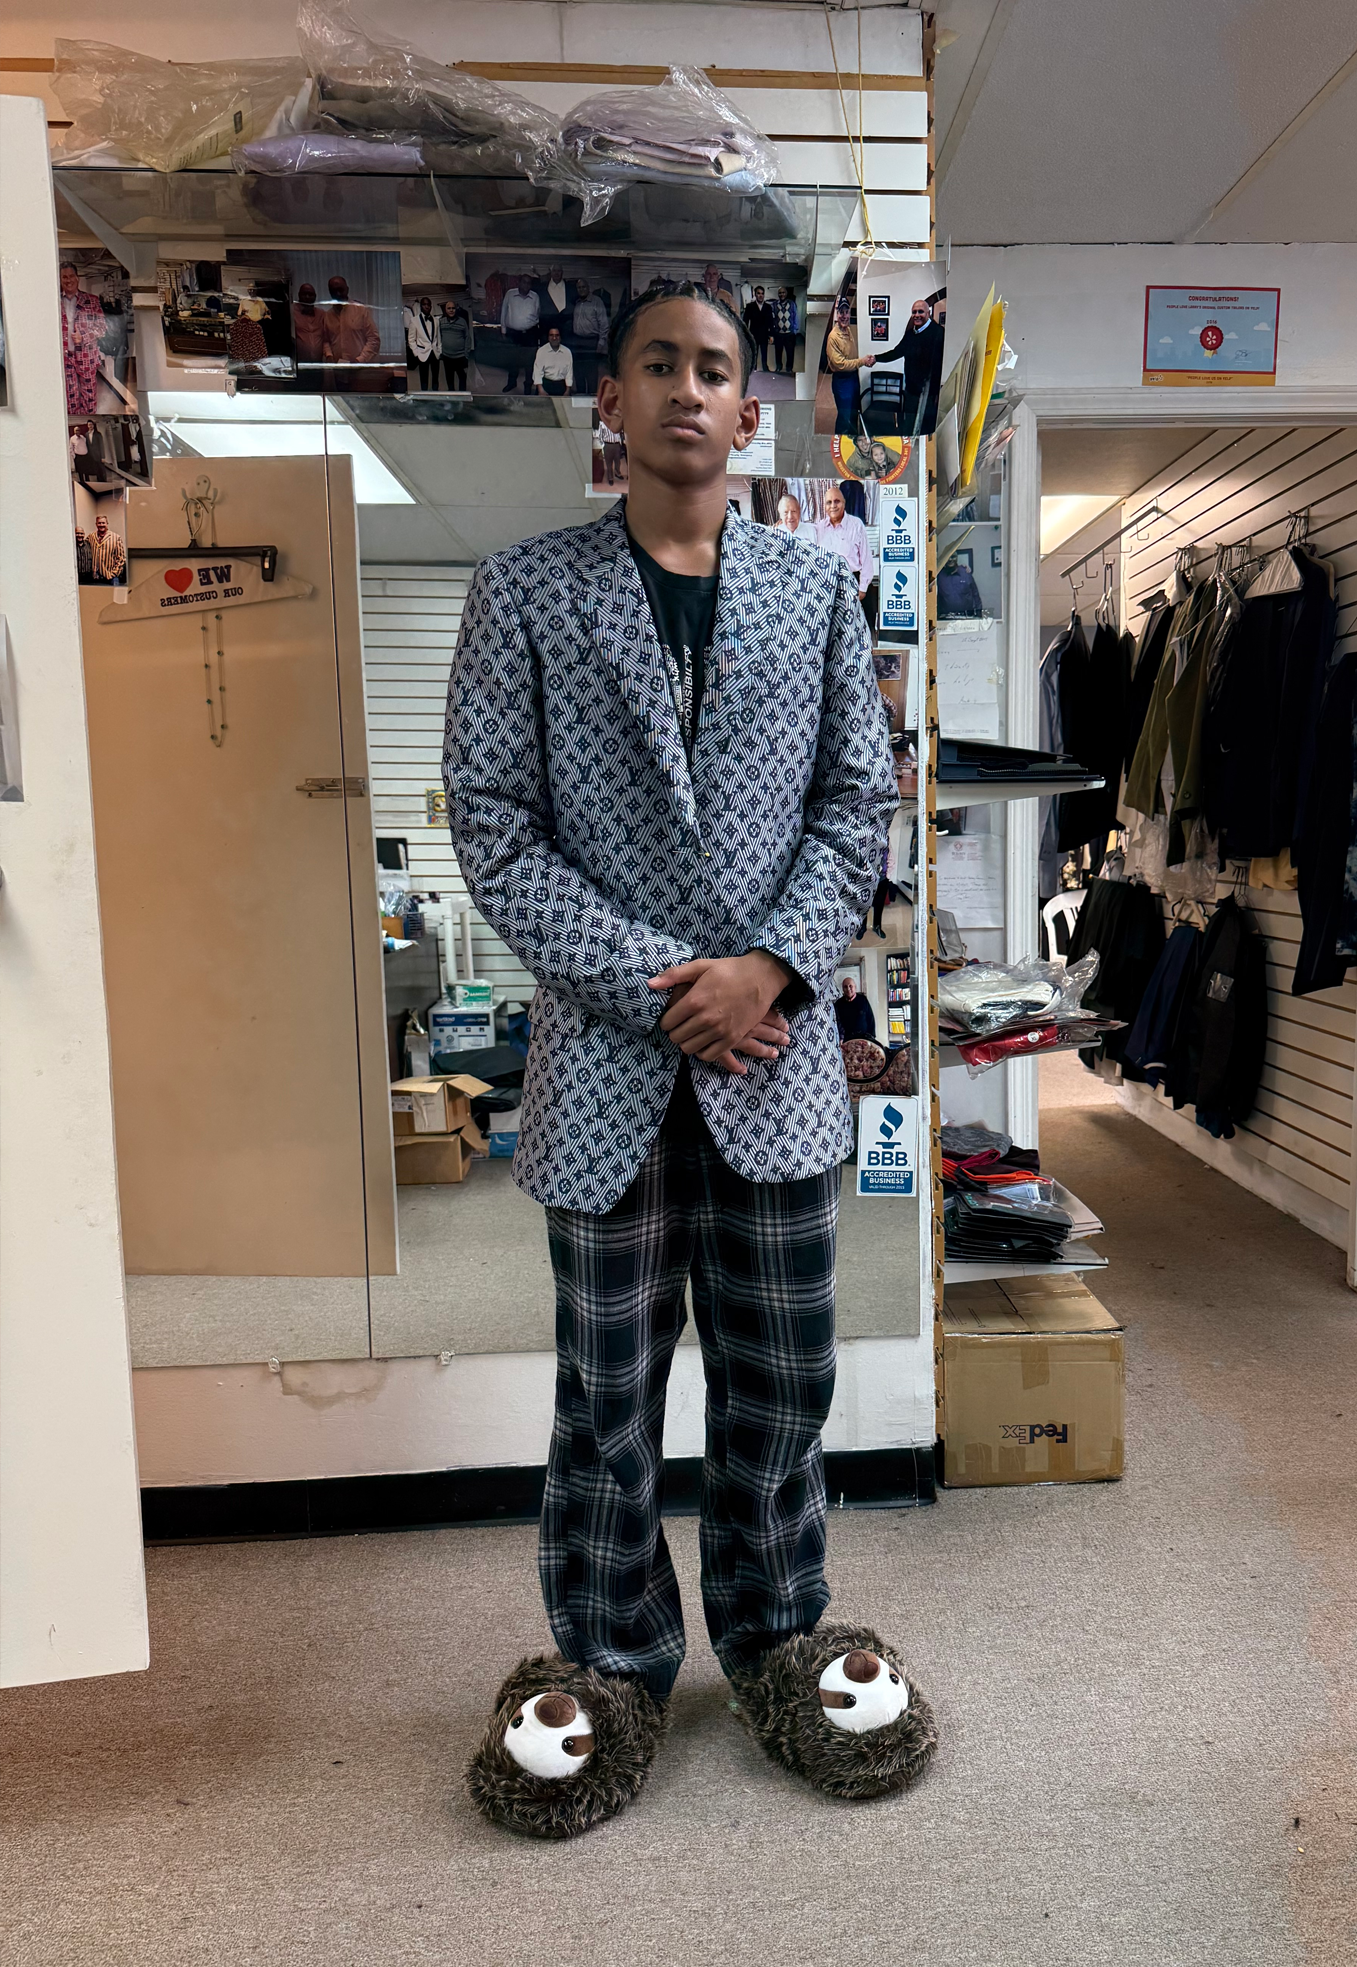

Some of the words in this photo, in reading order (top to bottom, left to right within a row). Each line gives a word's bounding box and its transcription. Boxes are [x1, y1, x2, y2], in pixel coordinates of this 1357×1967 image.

[883, 487, 904, 496] 2012
[886, 534, 912, 545] BBB
[886, 599, 912, 610] BBB
[867, 1150, 908, 1167] BBB
[1002, 1424, 1068, 1444] FedEx
